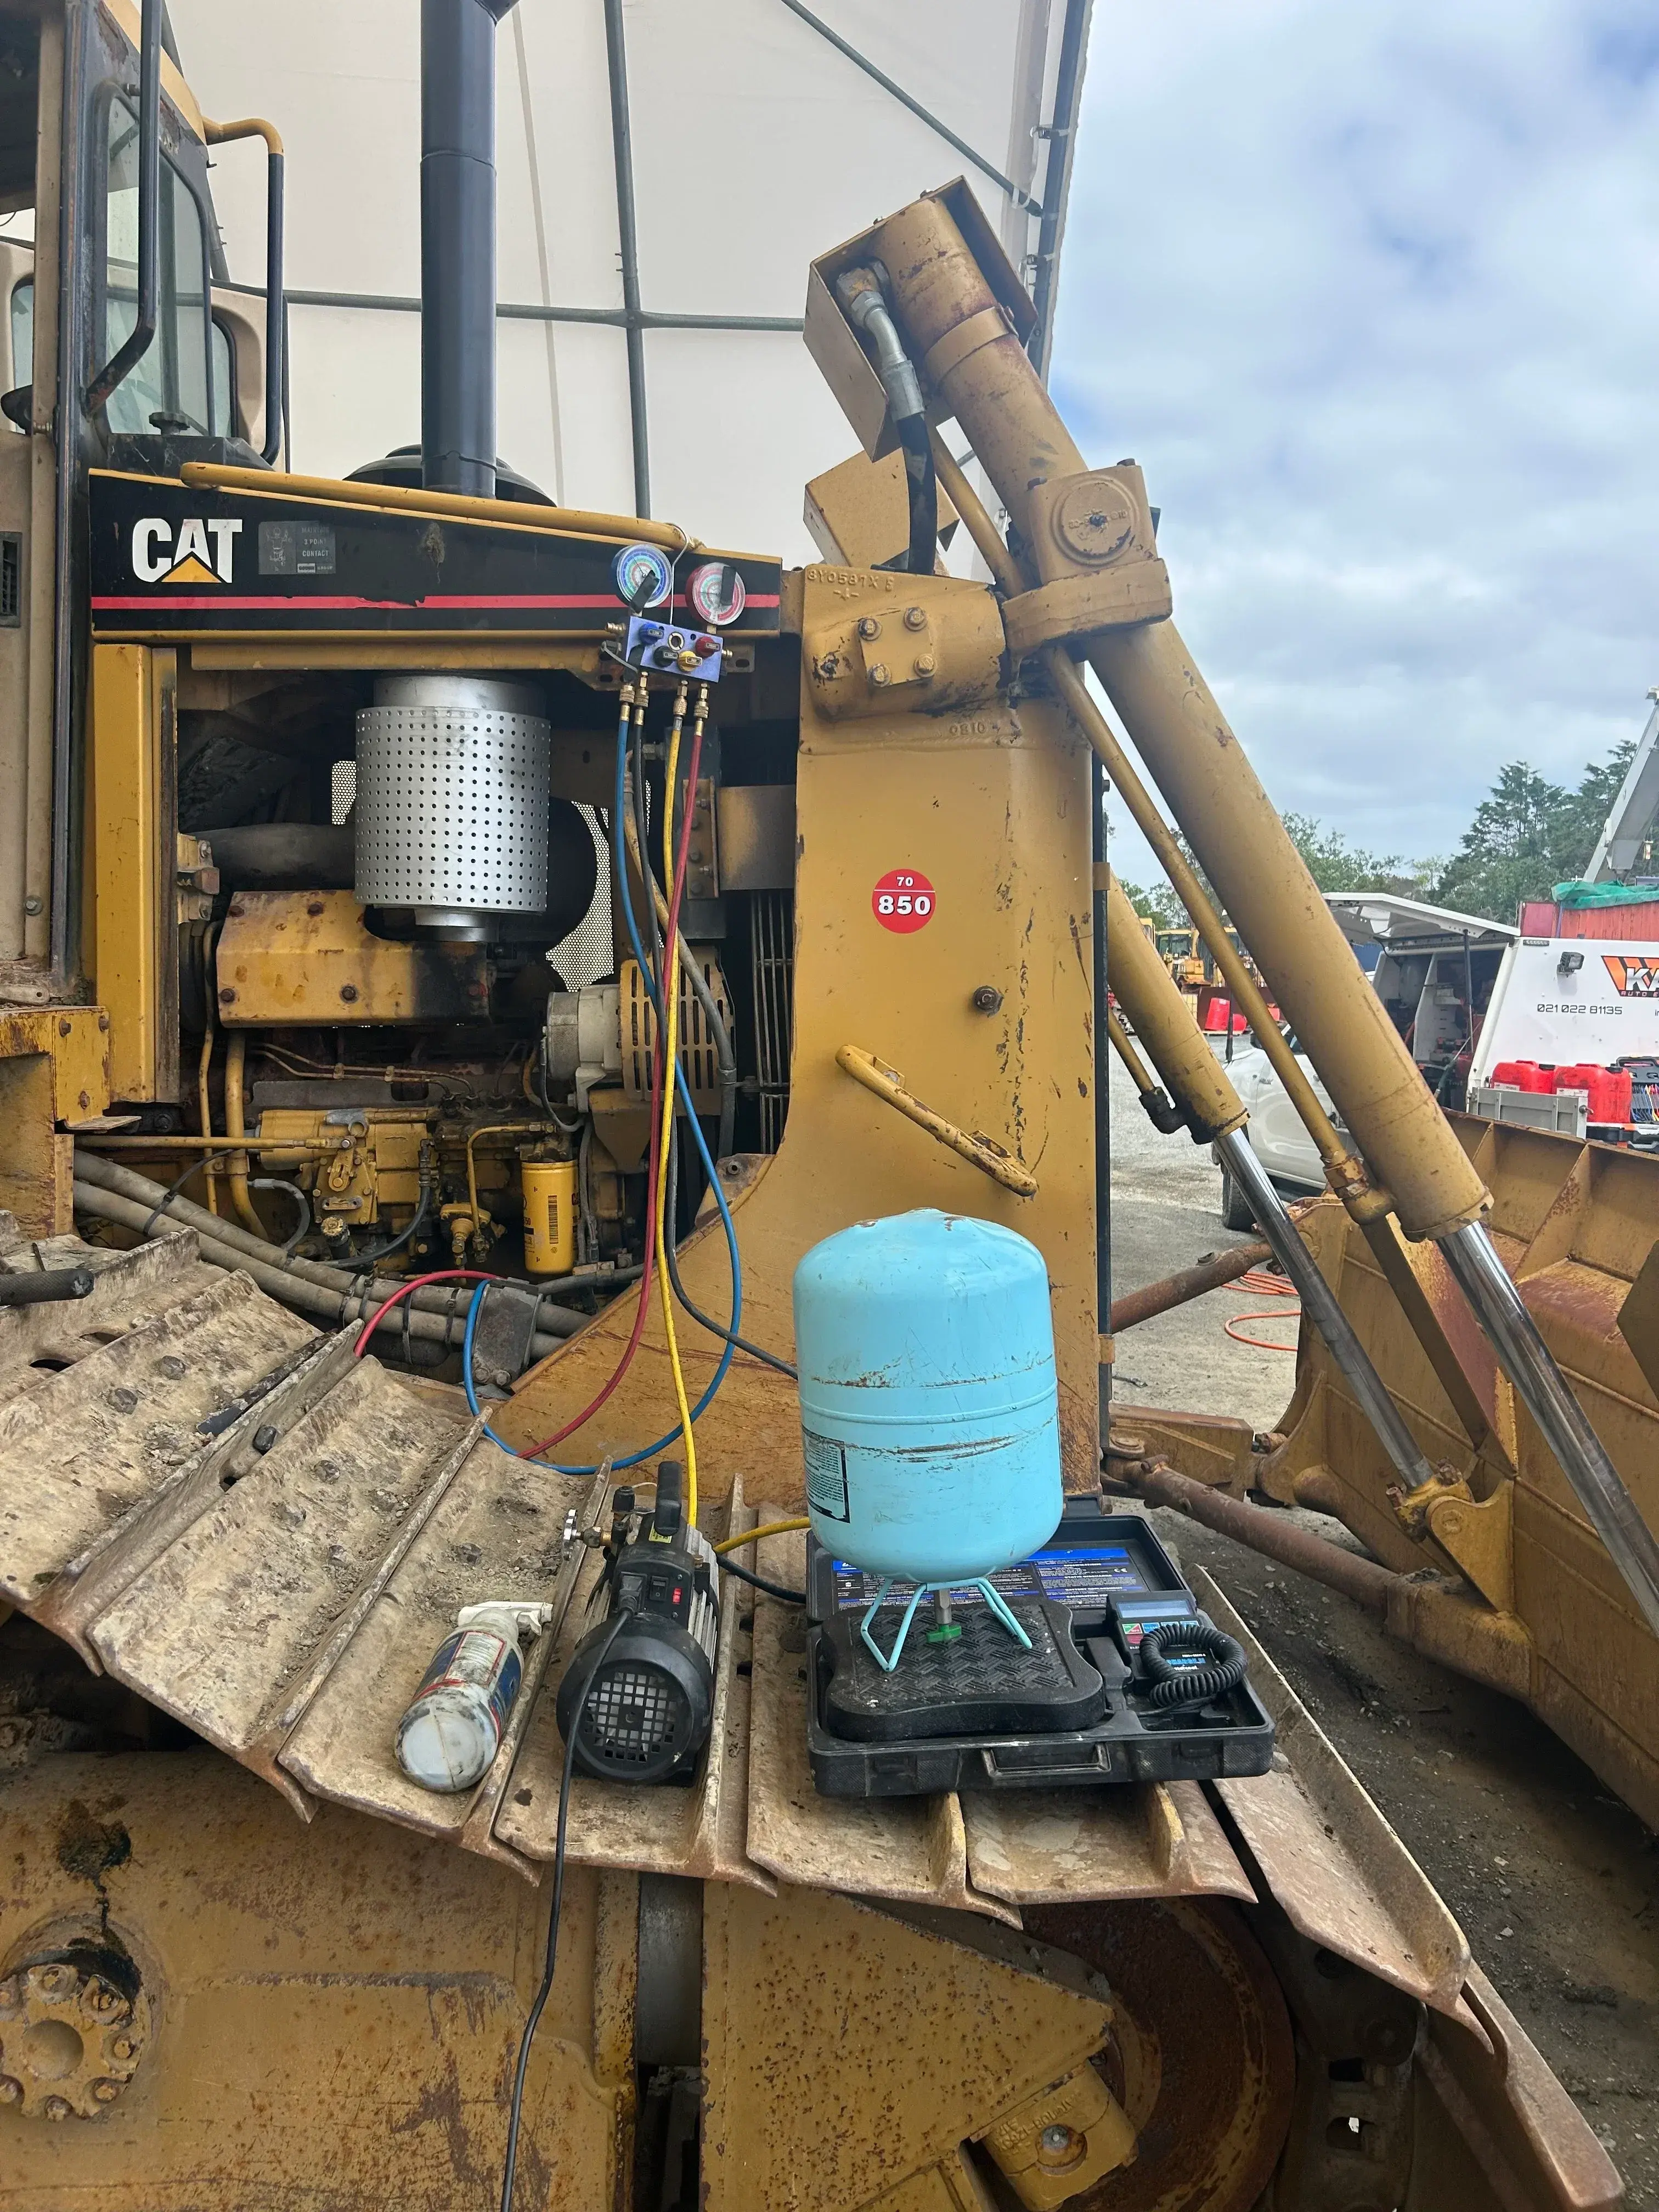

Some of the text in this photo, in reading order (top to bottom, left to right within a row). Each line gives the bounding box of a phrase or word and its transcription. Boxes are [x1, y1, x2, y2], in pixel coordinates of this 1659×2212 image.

[132, 518, 242, 583] CAT
[896, 876, 913, 887] 70
[878, 895, 931, 916] 850
[1537, 1004, 1622, 1015] 021 022 81135
